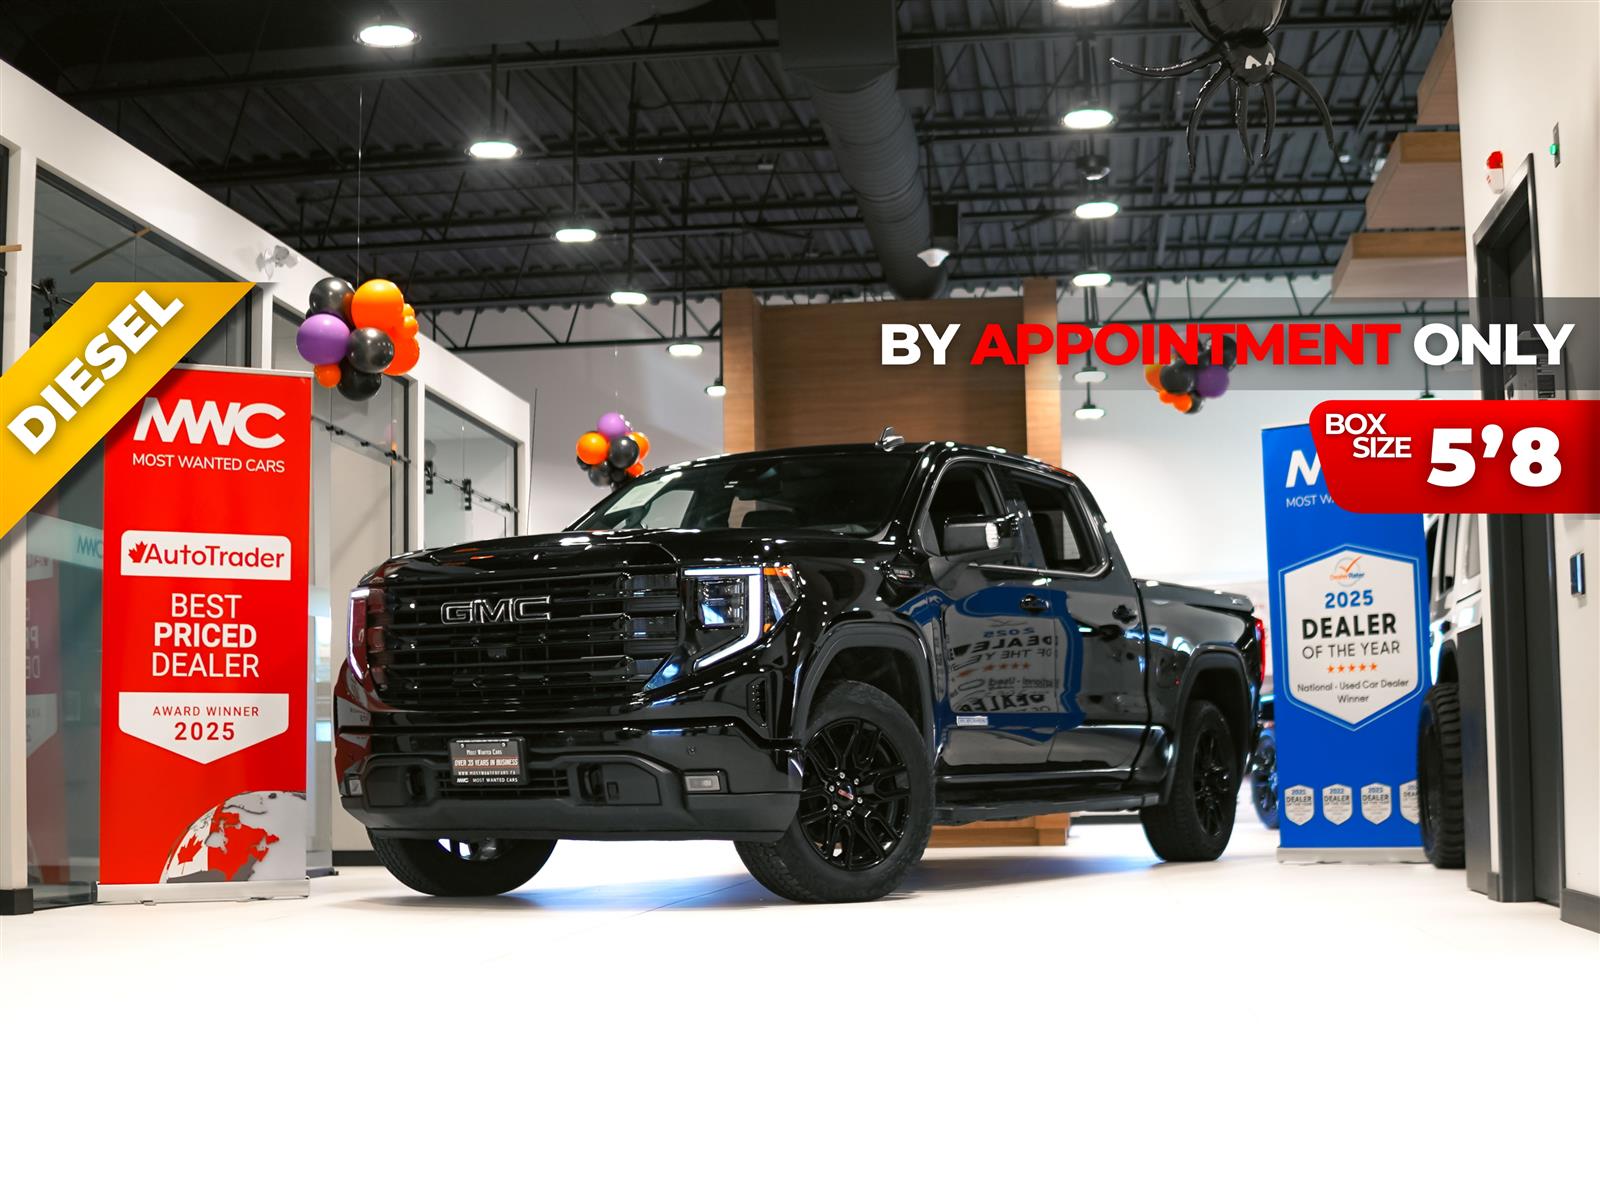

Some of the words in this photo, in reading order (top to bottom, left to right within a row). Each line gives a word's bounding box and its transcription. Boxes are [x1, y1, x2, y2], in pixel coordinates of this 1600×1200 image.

[133, 397, 286, 449] MWC
[132, 453, 175, 468] MOST
[177, 455, 242, 471] WANTED
[245, 458, 285, 473] CARS
[1286, 494, 1317, 508] MOST
[144, 543, 285, 568] AutoTrader
[171, 592, 242, 619] BEST
[1325, 589, 1374, 609] 2025
[440, 595, 550, 625] GMC
[154, 622, 257, 648] PRICED
[1302, 613, 1396, 640] DEALER
[1302, 645, 1323, 659] OF
[1328, 643, 1356, 657] THE
[1360, 640, 1400, 656] YEAR
[152, 652, 260, 678] DEALER
[1297, 683, 1333, 692] National
[1340, 681, 1360, 690] Used
[1362, 680, 1378, 689] Car
[1380, 679, 1409, 688] Dealer
[1337, 694, 1369, 703] Winner
[152, 705, 201, 717] AWARD
[206, 706, 260, 717] WINNER
[174, 722, 236, 741] 2025
